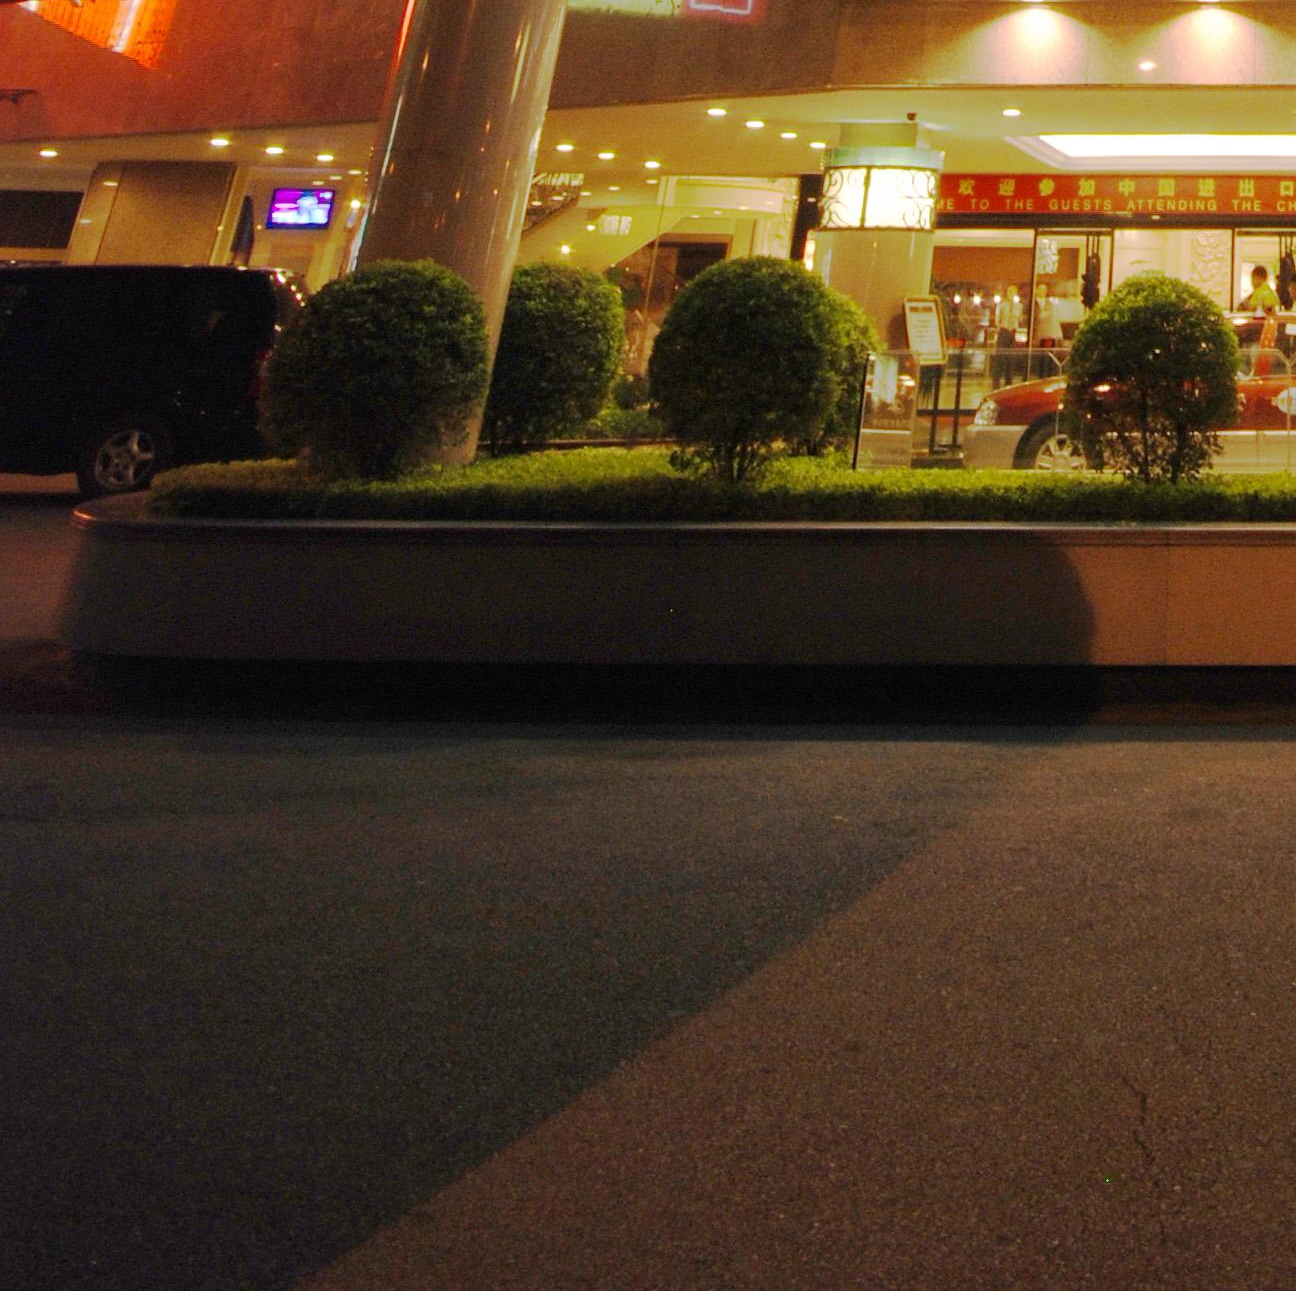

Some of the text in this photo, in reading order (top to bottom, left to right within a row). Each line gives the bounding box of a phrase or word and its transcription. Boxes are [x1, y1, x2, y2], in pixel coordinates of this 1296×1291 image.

[970, 199, 990, 210] TO
[1005, 199, 1034, 211] THE
[1049, 199, 1112, 211] GUESTS
[1126, 199, 1218, 211] ATTENDING
[1232, 199, 1262, 212] THE
